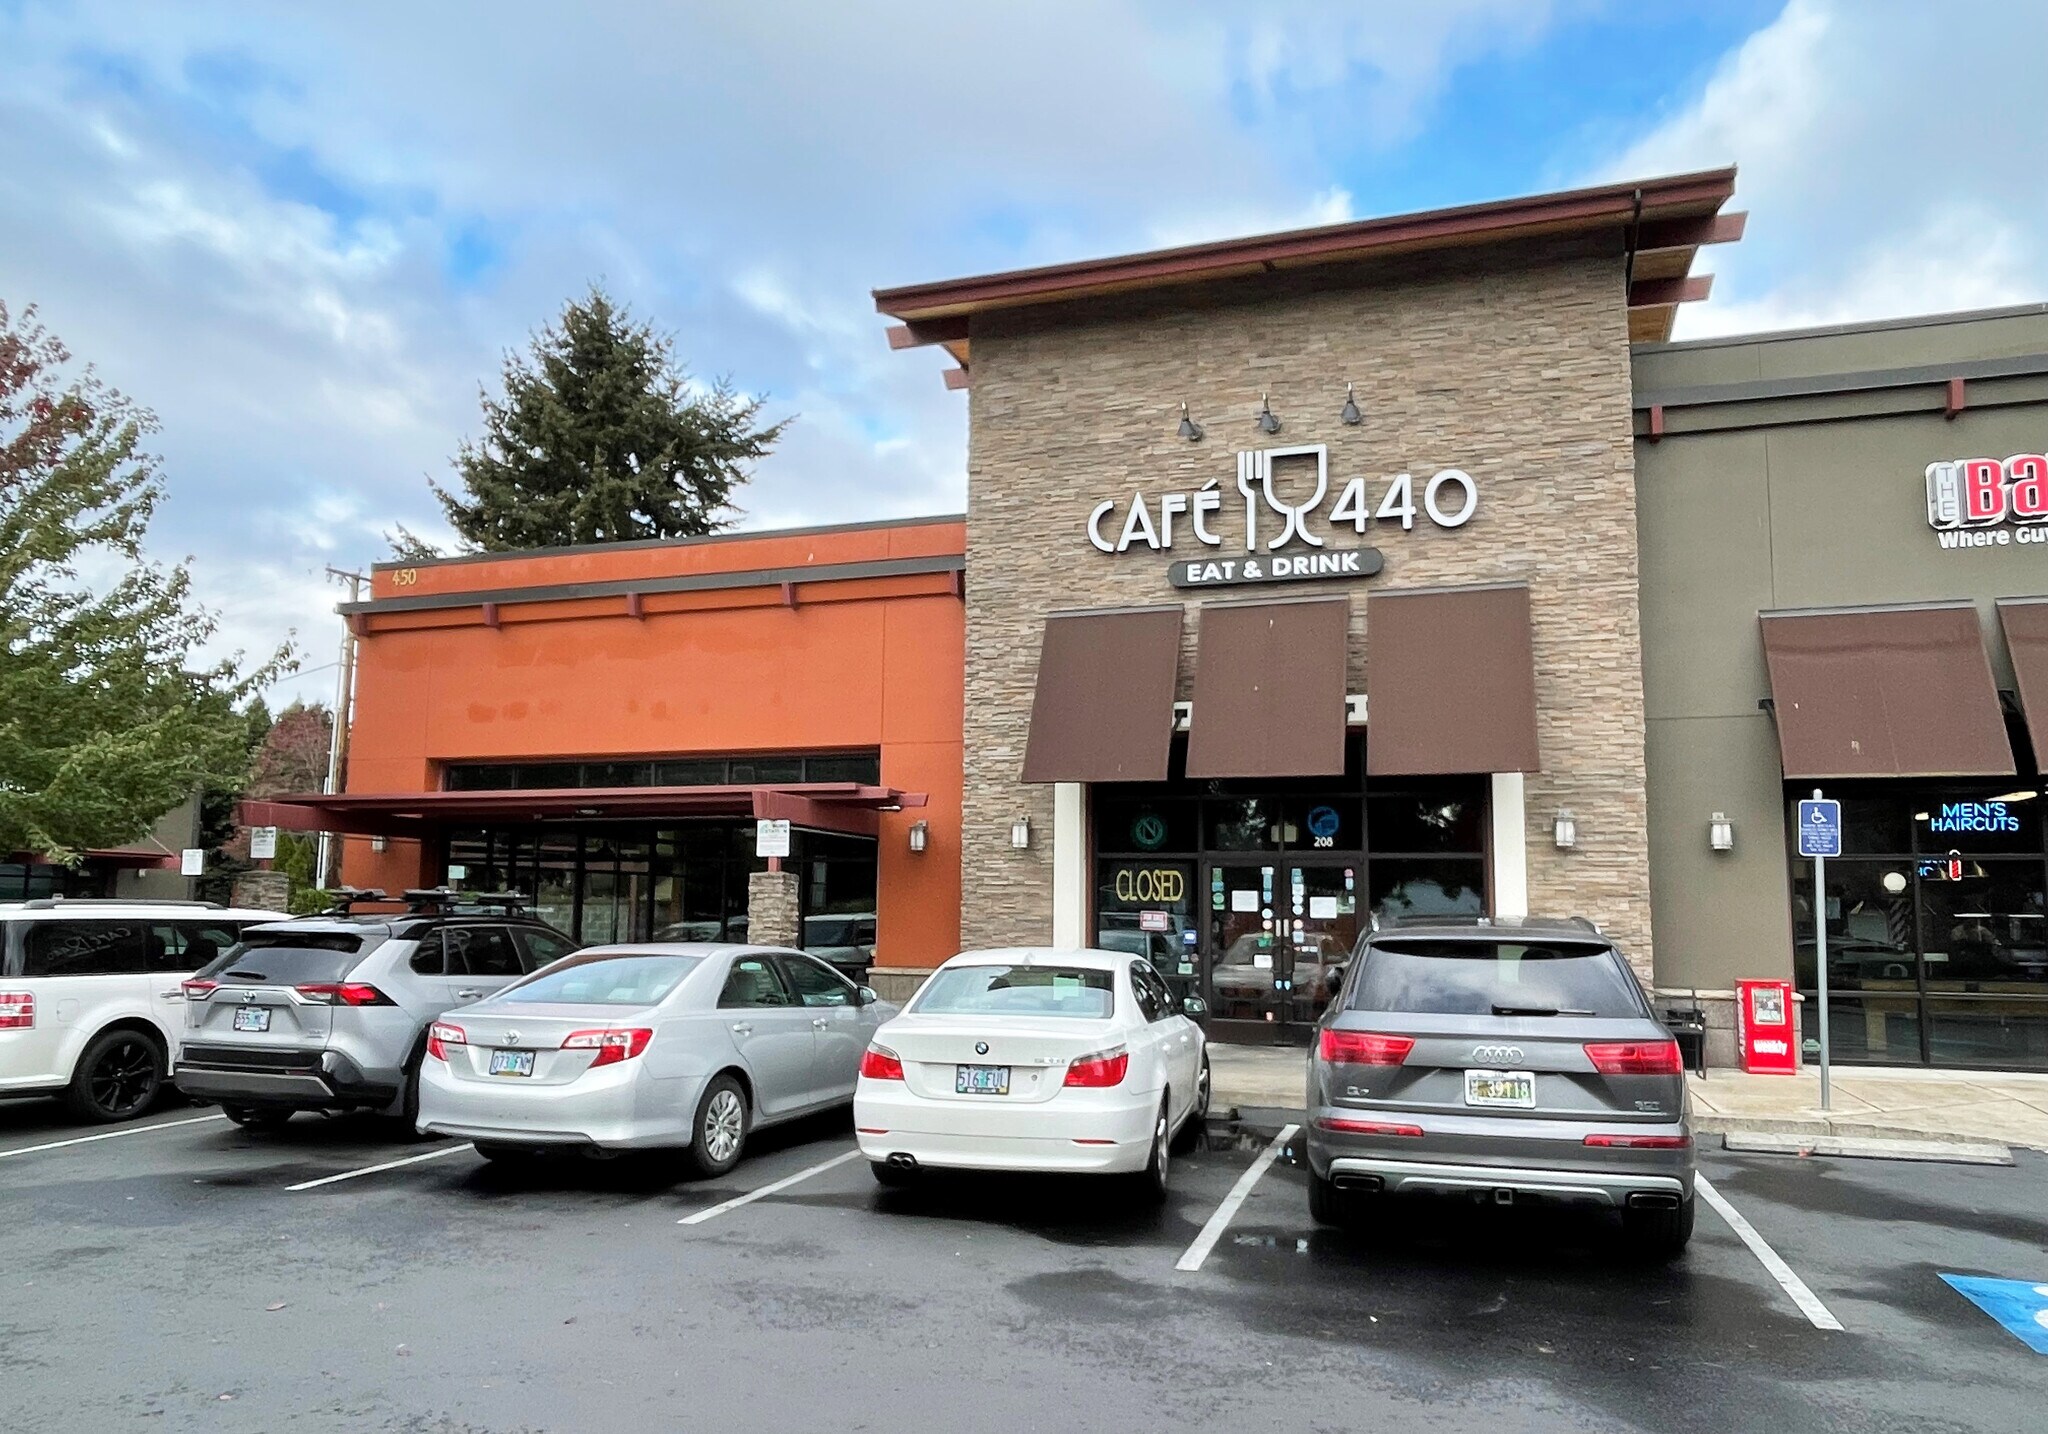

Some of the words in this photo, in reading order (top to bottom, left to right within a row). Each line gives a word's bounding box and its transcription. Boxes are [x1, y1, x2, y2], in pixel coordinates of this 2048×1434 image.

[1939, 466, 1957, 517] THE
[1087, 478, 1222, 553] CAFÉ
[1329, 468, 1479, 533] 440
[1938, 529, 2010, 549] Where
[392, 568, 417, 586] 450
[1186, 561, 1234, 583] EAT
[1243, 561, 1263, 579] &
[1272, 552, 1360, 577] DRINK
[1942, 803, 2006, 818] MEN'S
[1931, 817, 2019, 831] HAIRCUTS
[1314, 836, 1334, 848] 208
[1116, 869, 1184, 902] CLOSED
